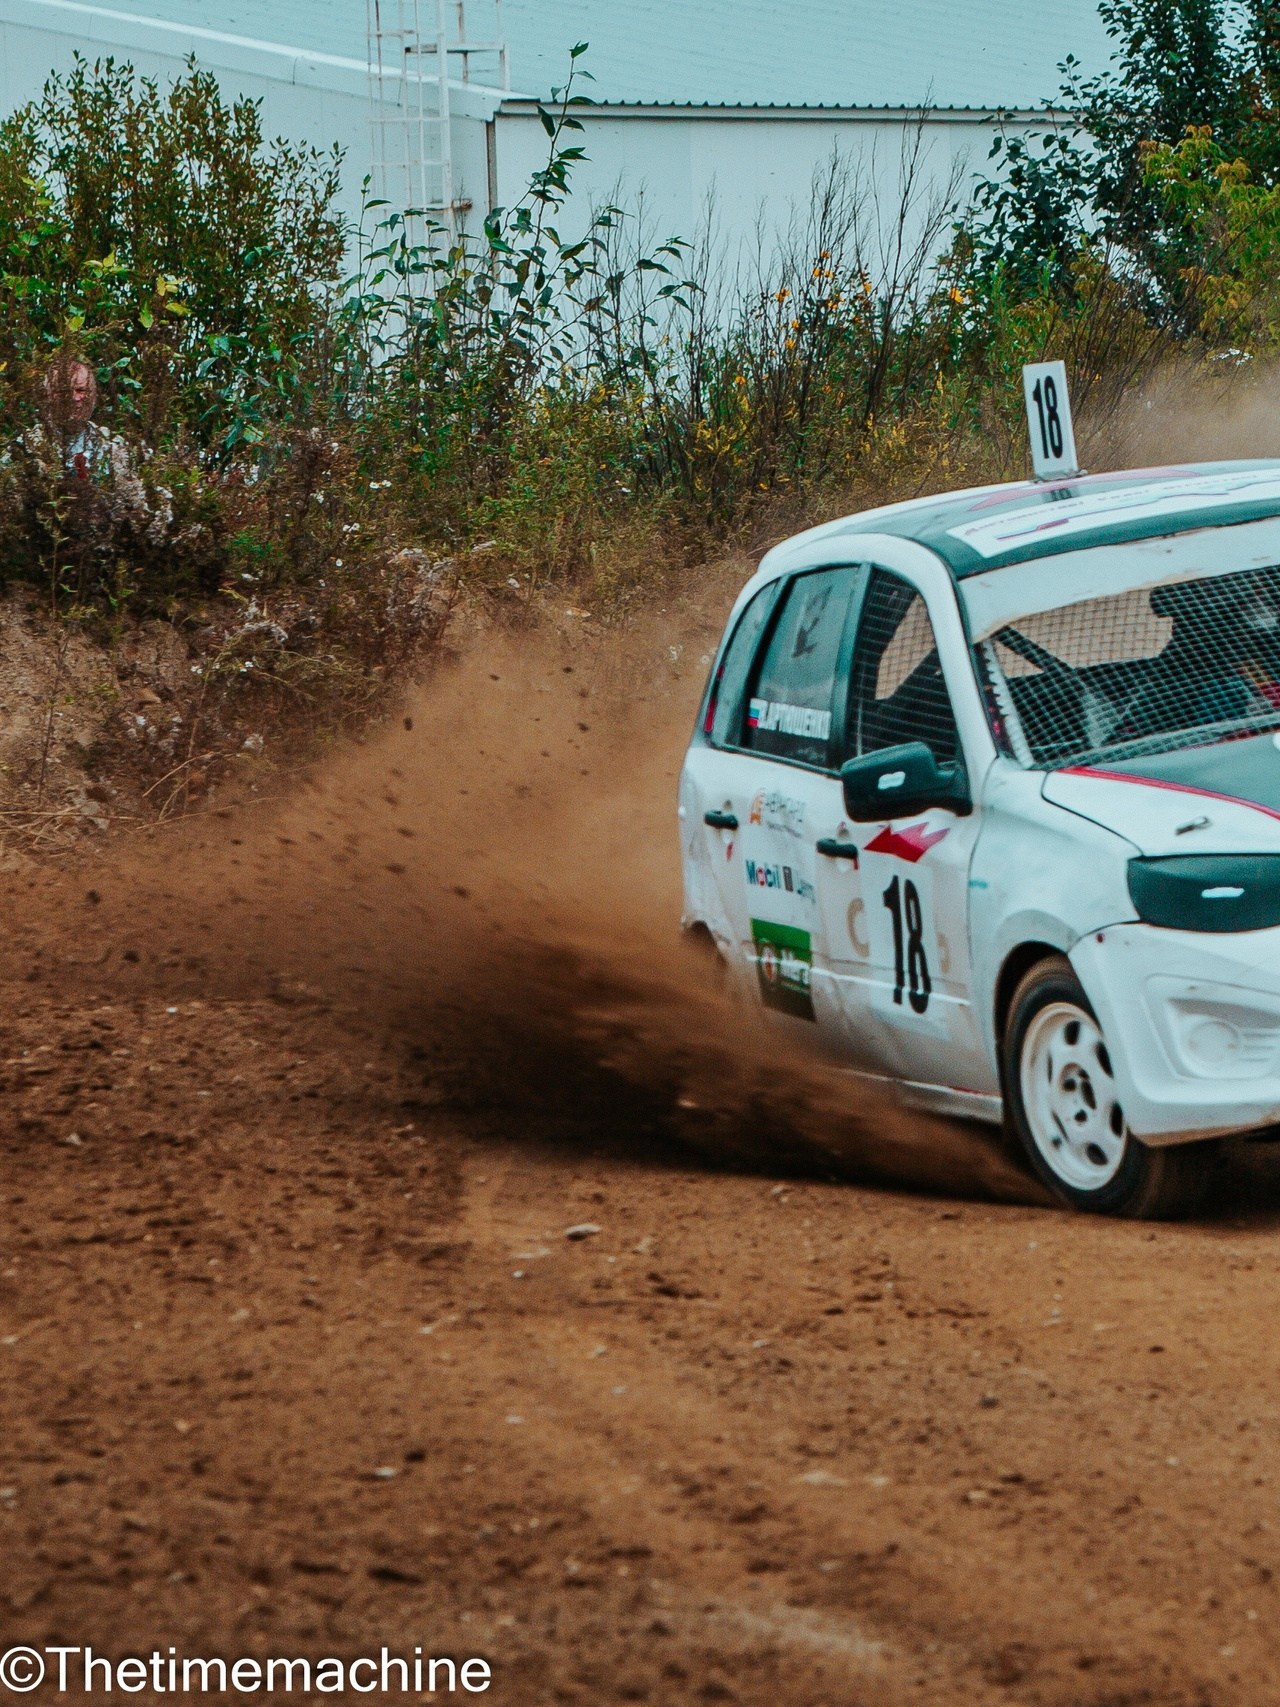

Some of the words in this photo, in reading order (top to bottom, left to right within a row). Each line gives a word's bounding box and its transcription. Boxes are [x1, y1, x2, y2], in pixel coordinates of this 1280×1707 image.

[1033, 375, 1063, 459] 18
[745, 859, 781, 889] Mobil
[883, 875, 932, 1014] 18
